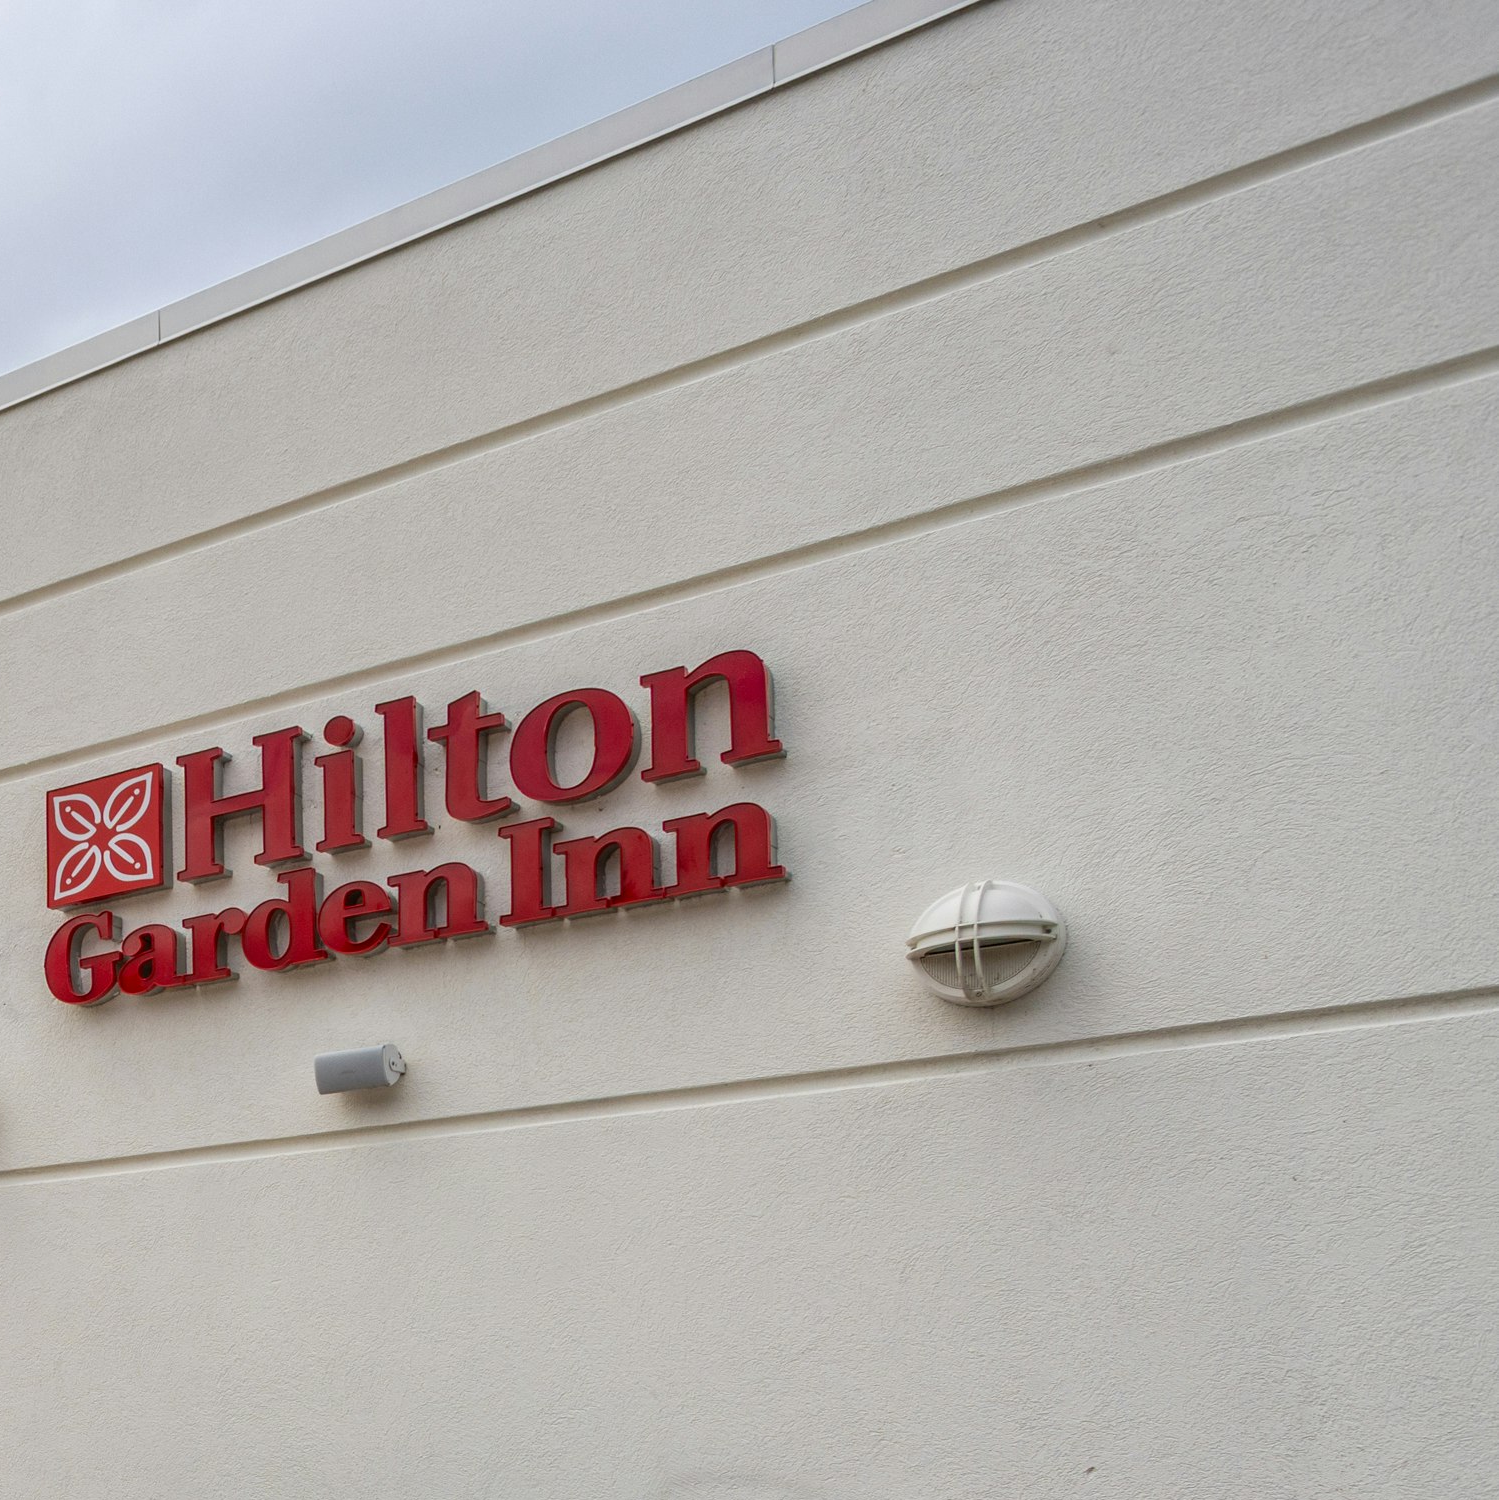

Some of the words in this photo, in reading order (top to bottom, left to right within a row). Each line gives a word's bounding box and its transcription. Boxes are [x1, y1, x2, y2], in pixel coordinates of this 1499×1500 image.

[175, 649, 784, 882] Hilton
[43, 863, 490, 1006] Garden
[497, 801, 786, 928] Inn
